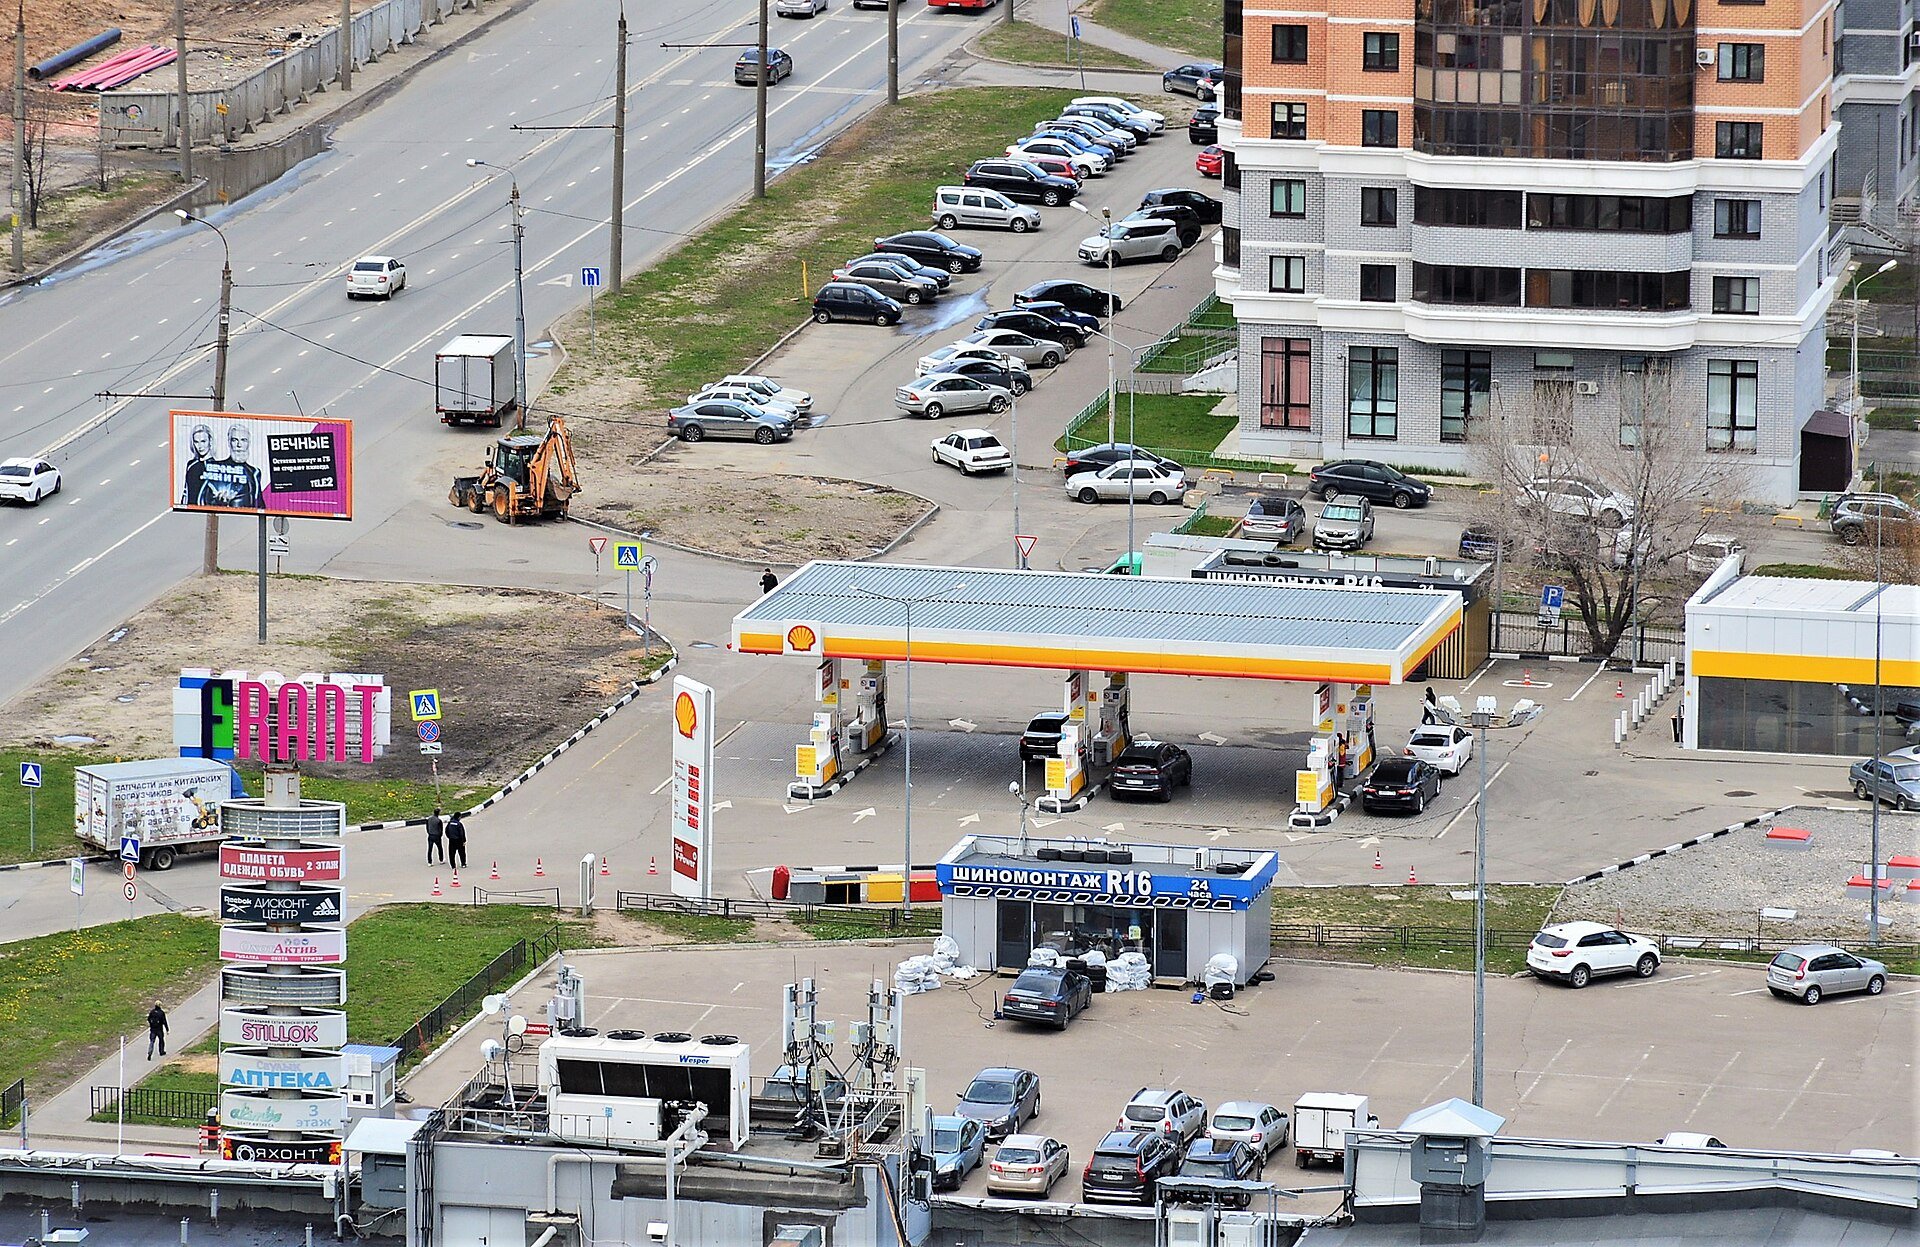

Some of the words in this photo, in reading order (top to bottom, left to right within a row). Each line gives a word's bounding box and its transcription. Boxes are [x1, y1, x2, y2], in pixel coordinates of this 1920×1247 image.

[271, 436, 330, 451] ВЕЧНЫЕ
[310, 476, 334, 488] TELE2
[240, 853, 286, 865] ПЛАНЕТА
[306, 862, 313, 870] 2
[315, 860, 339, 870] ЭТАЖ
[223, 863, 266, 877] ОДЕЖДА
[269, 866, 305, 878] ОБУВЬ
[952, 867, 1101, 889] ШИНОМОНТАЖ
[1107, 869, 1152, 896] R16
[1190, 878, 1209, 891] 24
[127, 887, 133, 896] 5
[1187, 890, 1212, 899] часа
[224, 896, 252, 905] Reebok
[262, 909, 299, 919] ЦЕНТР
[312, 908, 340, 916] adidas
[242, 1022, 319, 1043] STILLOK
[679, 1055, 711, 1064] Wesper
[230, 1068, 333, 1088] АПТЕКА
[308, 1104, 319, 1117] 3
[296, 1118, 332, 1128] этаж
[256, 1148, 319, 1160] ЯХОНТ
